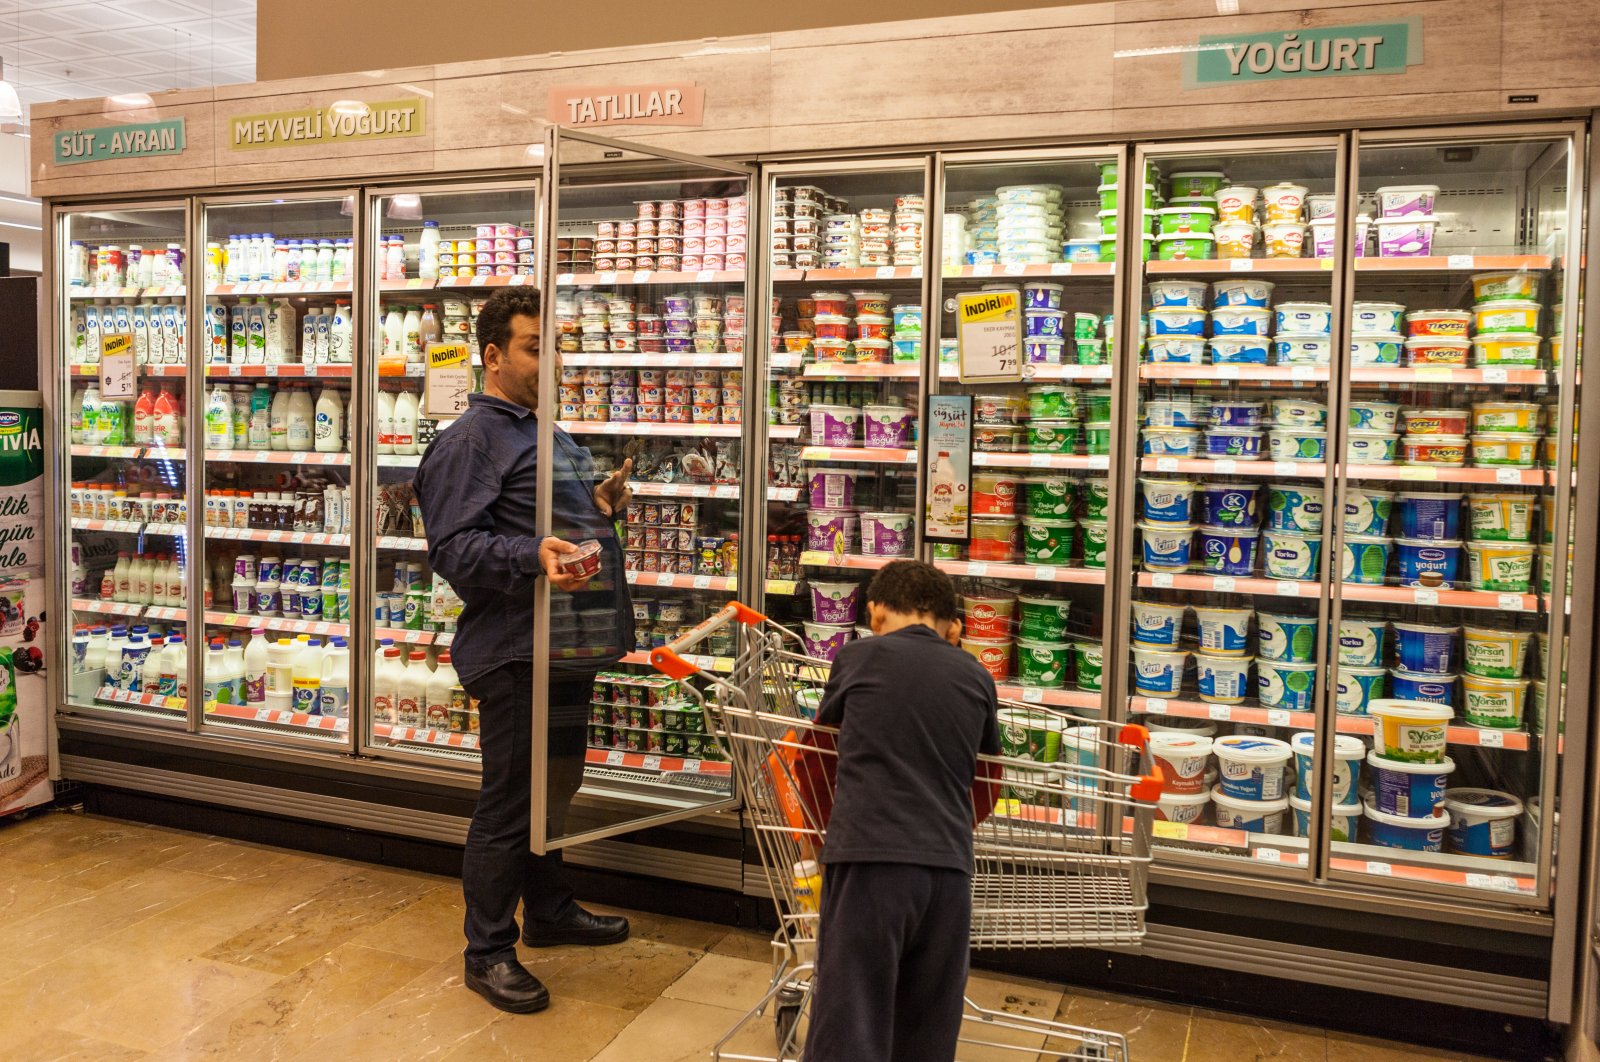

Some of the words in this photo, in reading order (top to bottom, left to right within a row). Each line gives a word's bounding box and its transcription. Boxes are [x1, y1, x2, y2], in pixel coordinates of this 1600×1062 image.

[1224, 34, 1384, 76] YOĞURT
[566, 89, 684, 124] TATLILAR
[235, 112, 323, 145] MEYVELİ
[327, 107, 416, 138] YOĞURT
[60, 132, 96, 157] SÜT
[111, 127, 177, 155] AYRAN
[965, 295, 1013, 317] İNDİRİM
[105, 336, 131, 352] İNDİRİM
[432, 347, 466, 364] İNDİRİM
[1000, 360, 1006, 370] 7
[1276, 550, 1297, 558] Torku
[1415, 560, 1448, 572] yoğurt
[1340, 638, 1362, 647] Torku
